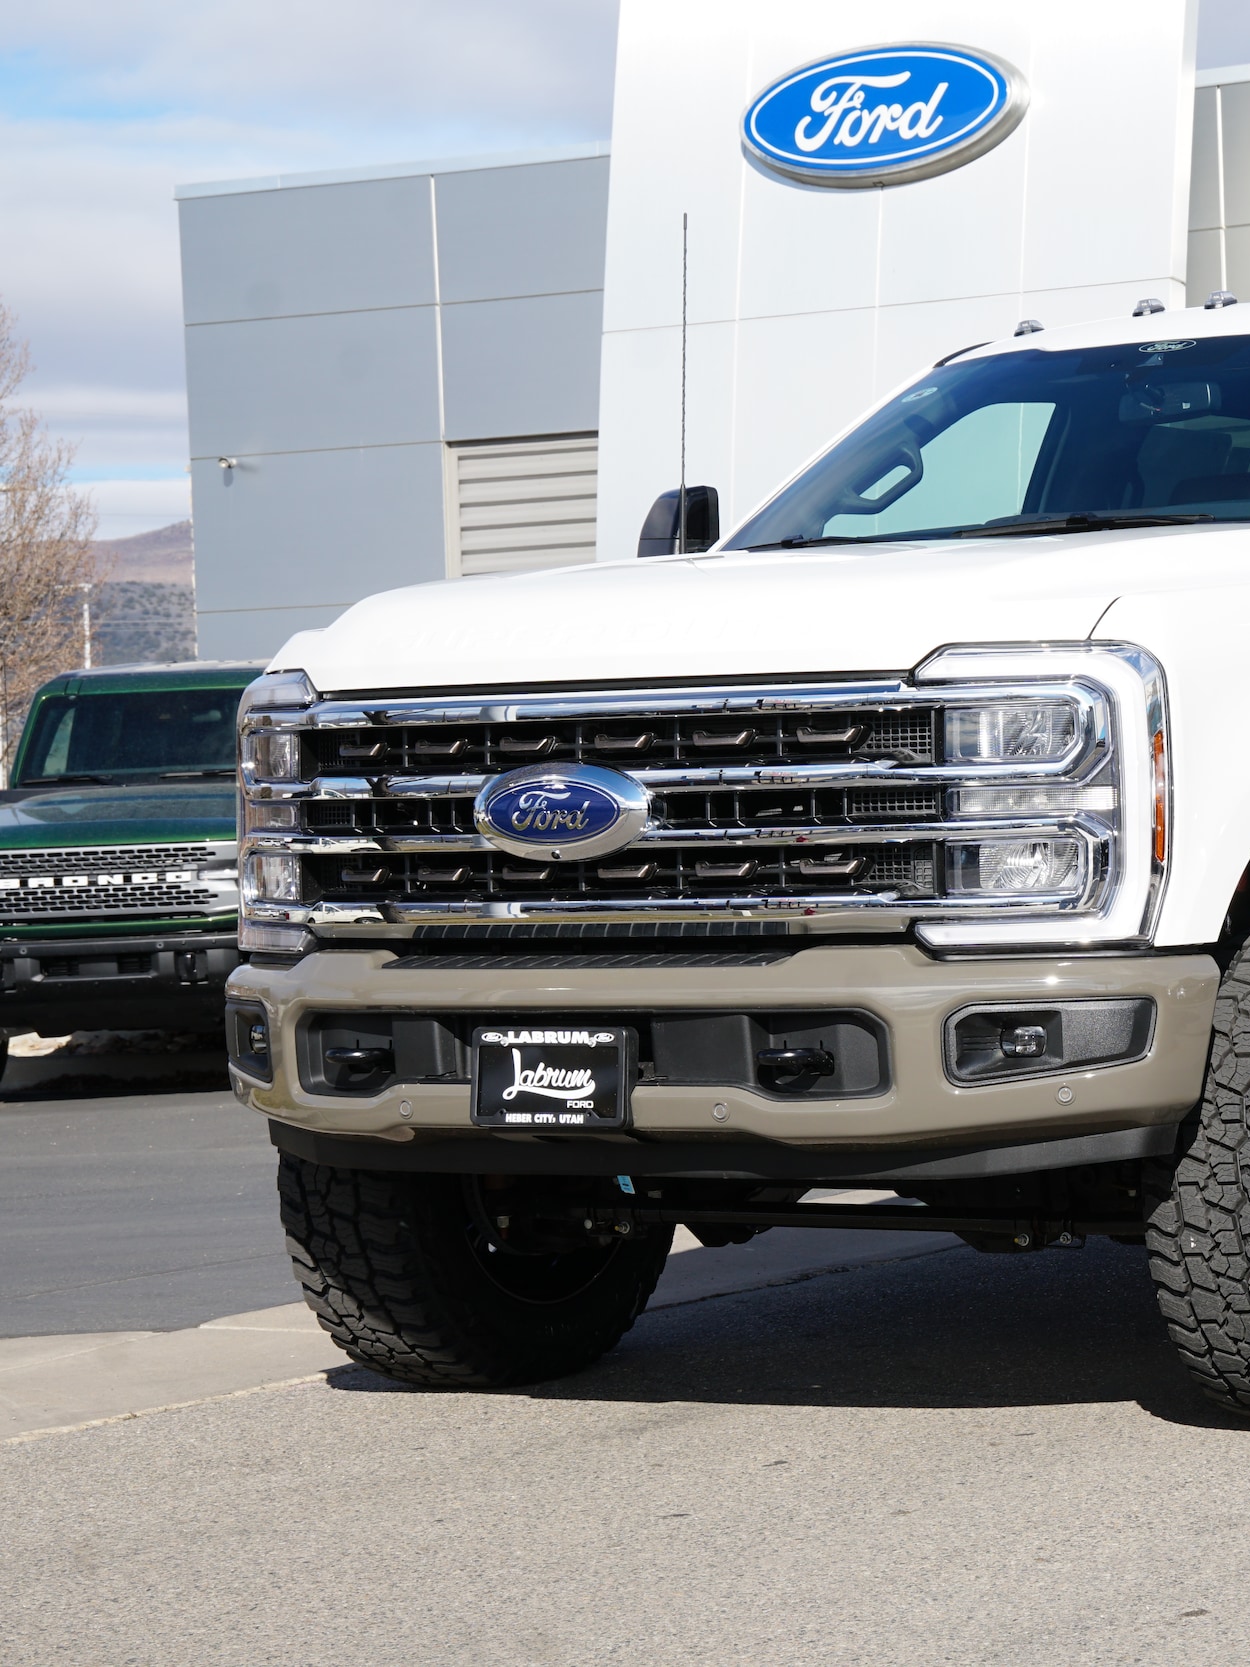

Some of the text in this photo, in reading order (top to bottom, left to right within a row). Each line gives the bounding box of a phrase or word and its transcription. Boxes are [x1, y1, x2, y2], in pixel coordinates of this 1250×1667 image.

[794, 71, 949, 153] Ford
[511, 790, 591, 832] Ford
[507, 1031, 590, 1044] LABRUM
[502, 1048, 596, 1100] Labrum
[566, 1100, 594, 1109] FORD
[505, 1113, 532, 1123] HEBER
[559, 1113, 584, 1124] UTAH
